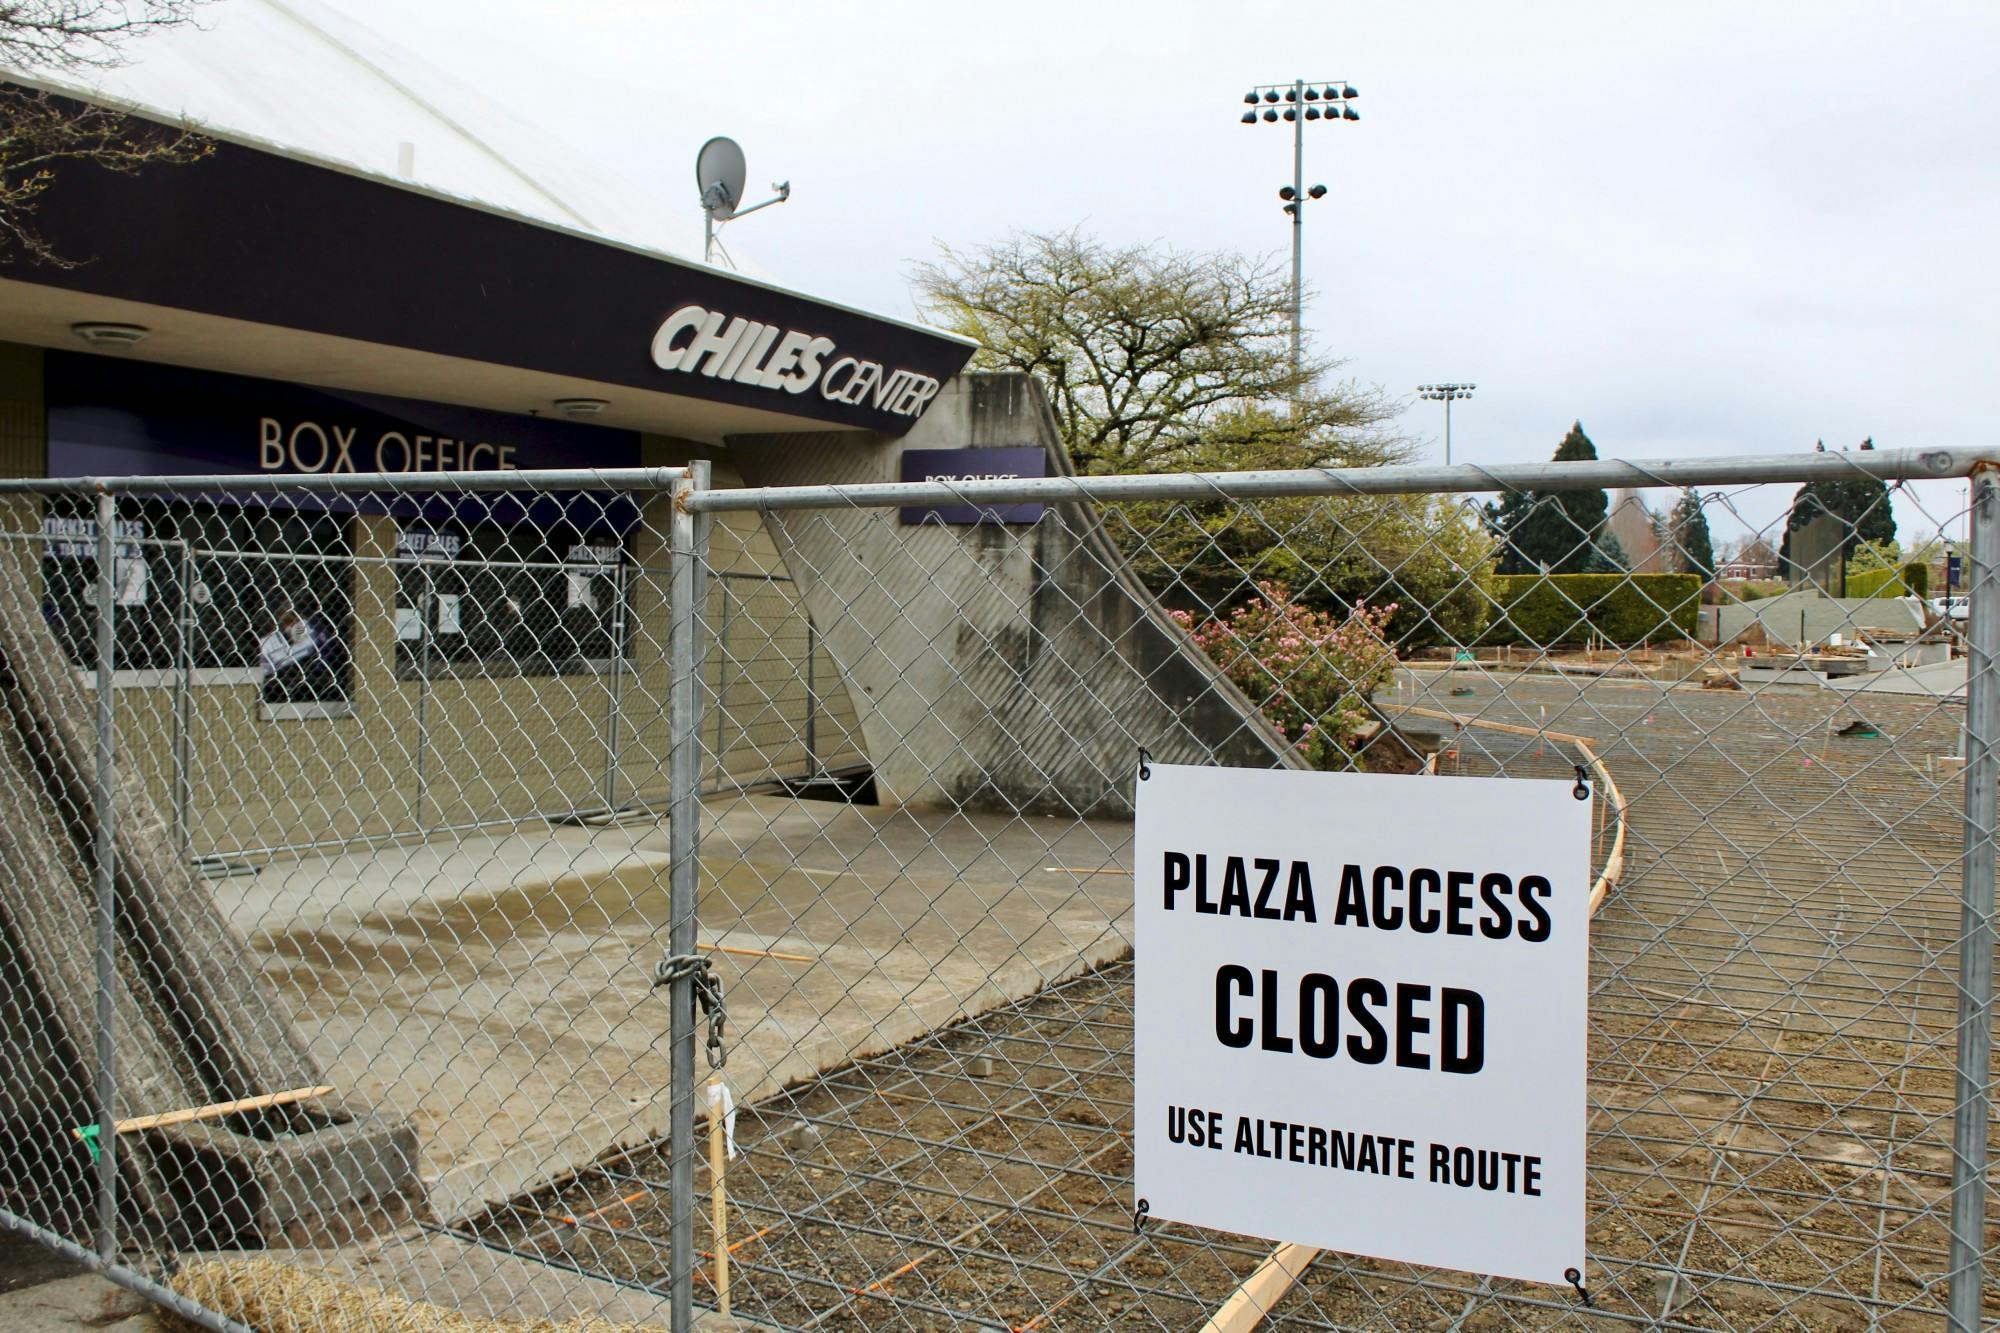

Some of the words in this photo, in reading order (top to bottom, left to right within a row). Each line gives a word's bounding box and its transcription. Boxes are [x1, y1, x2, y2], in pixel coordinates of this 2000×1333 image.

[651, 305, 836, 394] CHILES
[820, 357, 940, 418] CENTER
[260, 418, 357, 473] BOX
[1163, 851, 1317, 924] PLAZA
[1334, 864, 1552, 943] ACCESS
[1215, 964, 1485, 1075] CLOSED
[1168, 1105, 1223, 1150] USE
[1234, 1116, 1415, 1180] ALTERNATE
[1429, 1143, 1542, 1197] ROUTE
